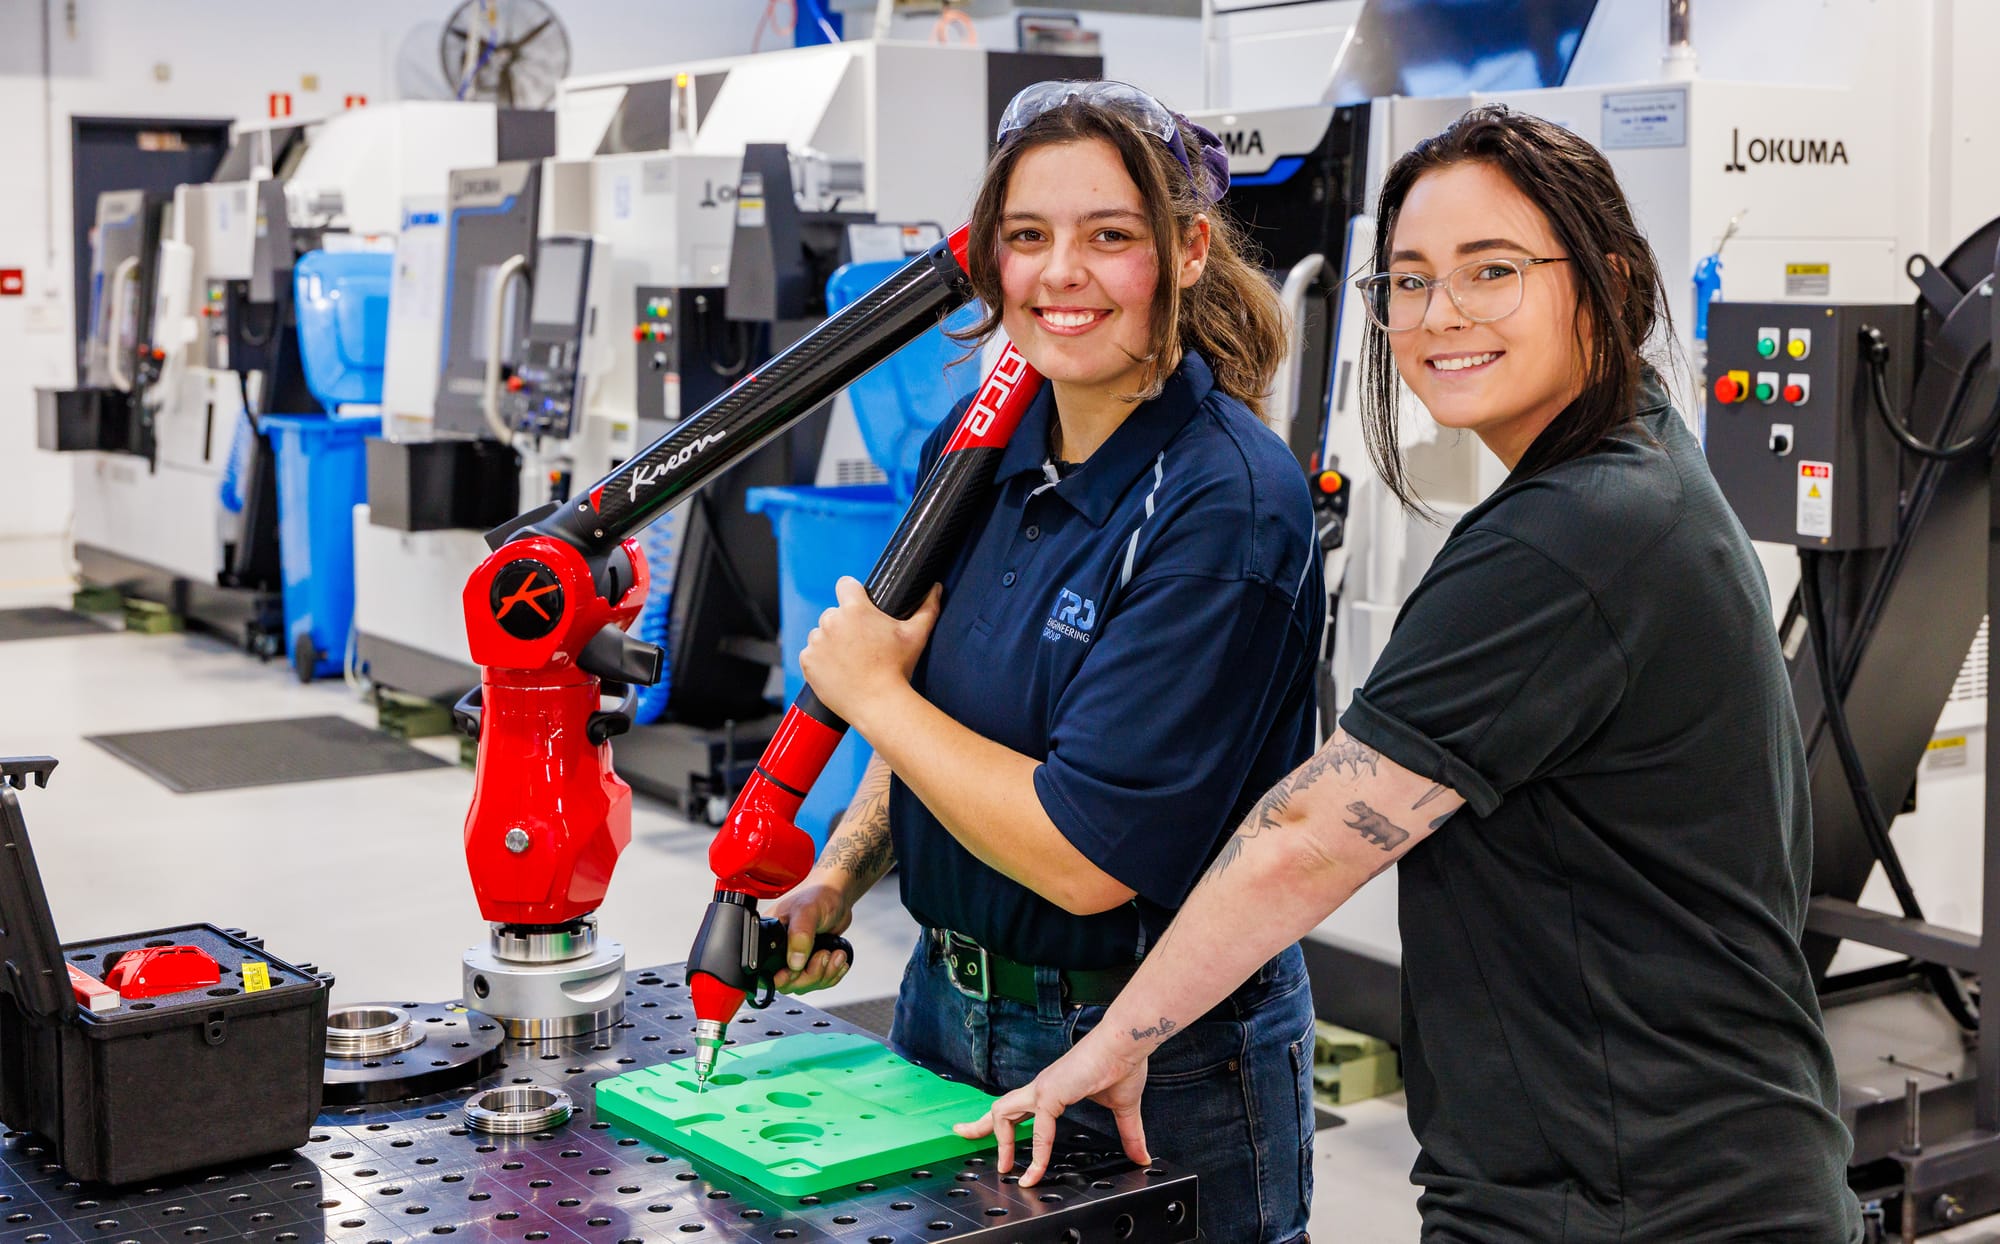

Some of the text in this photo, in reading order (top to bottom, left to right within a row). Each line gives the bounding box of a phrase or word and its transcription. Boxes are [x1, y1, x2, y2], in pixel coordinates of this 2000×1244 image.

[1218, 129, 1264, 155] MA
[1748, 138, 1849, 164] OKUMA
[964, 350, 1027, 437] ace
[627, 430, 726, 503] Kreon
[1042, 626, 1061, 642] GROUP
[1046, 617, 1090, 643] ENGINEERING
